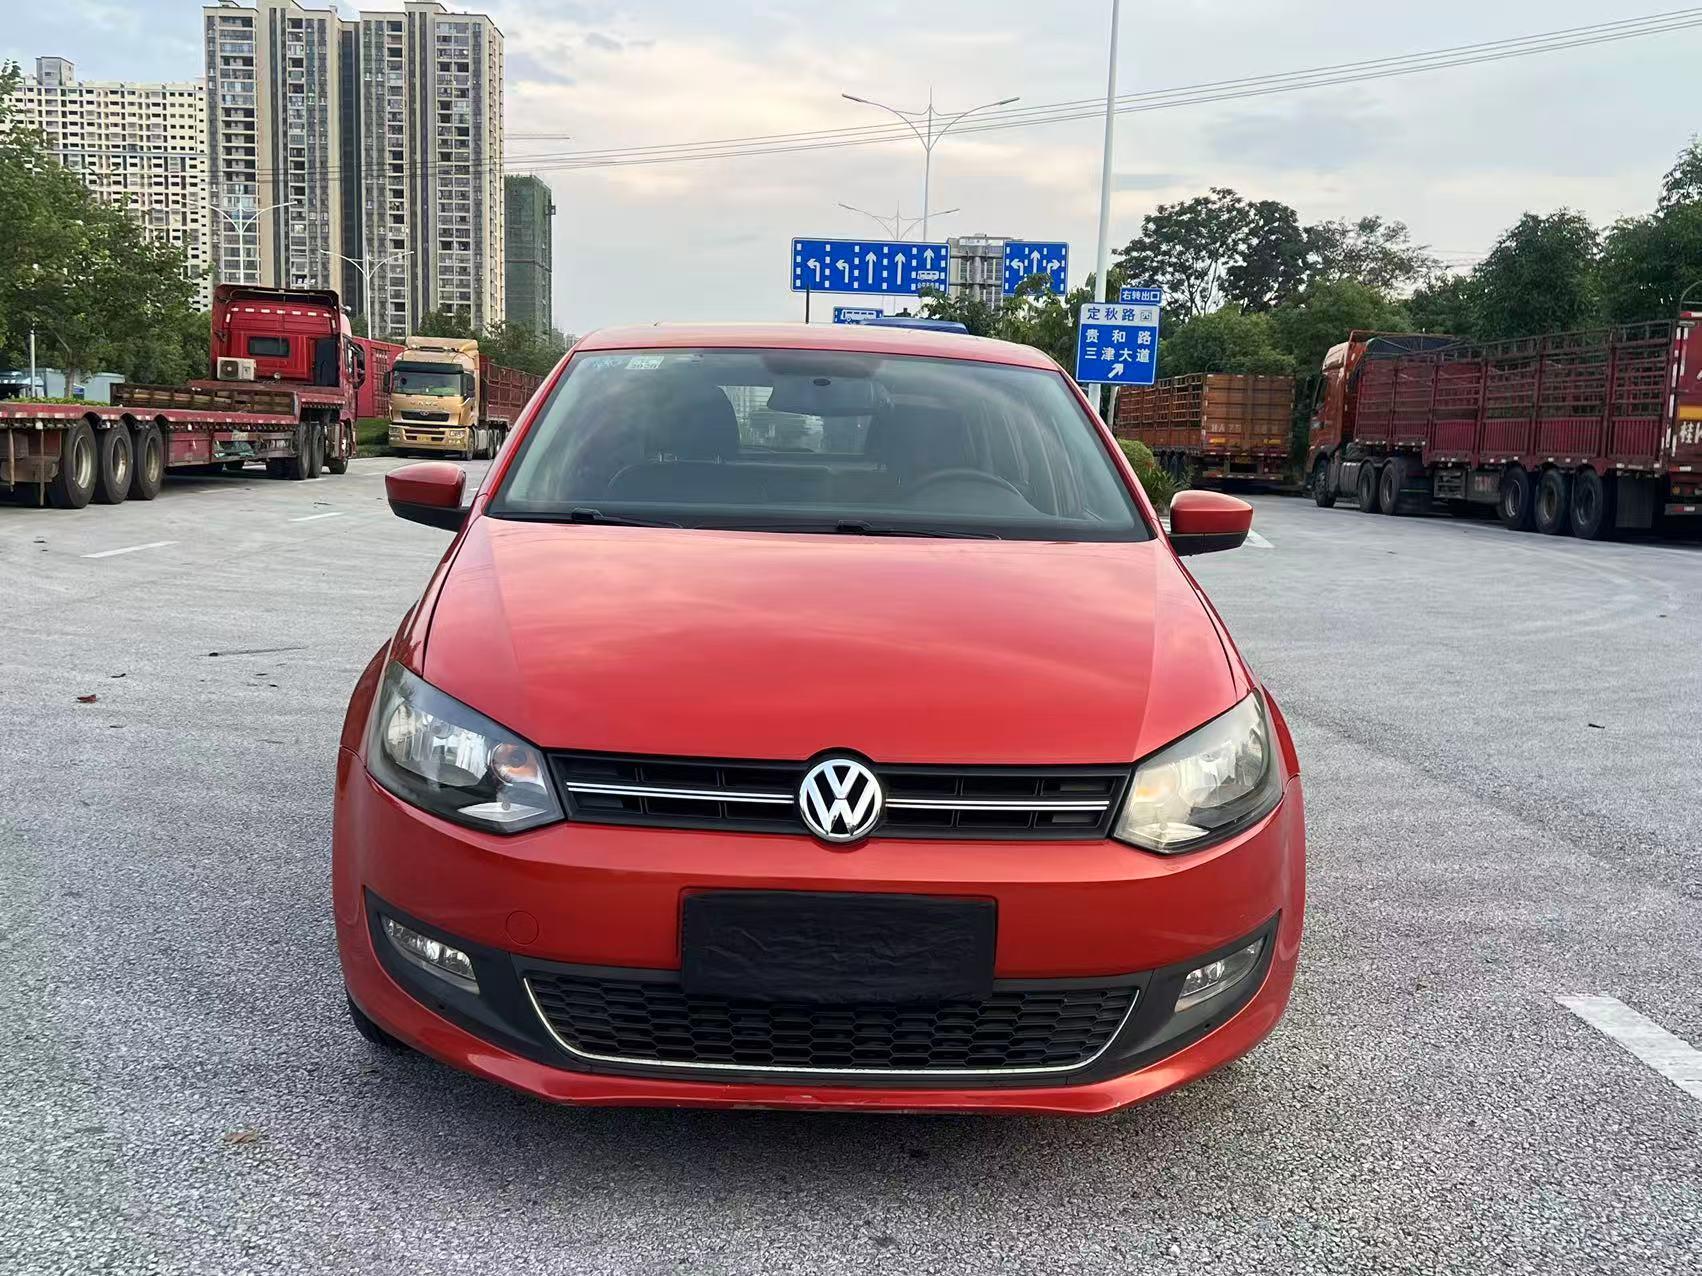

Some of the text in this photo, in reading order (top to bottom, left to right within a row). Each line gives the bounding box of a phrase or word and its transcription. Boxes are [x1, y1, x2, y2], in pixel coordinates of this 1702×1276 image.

[1122, 290, 1160, 301] 右转出口
[1087, 306, 1136, 321] 定秋路
[1084, 346, 1150, 363] 三津大道
